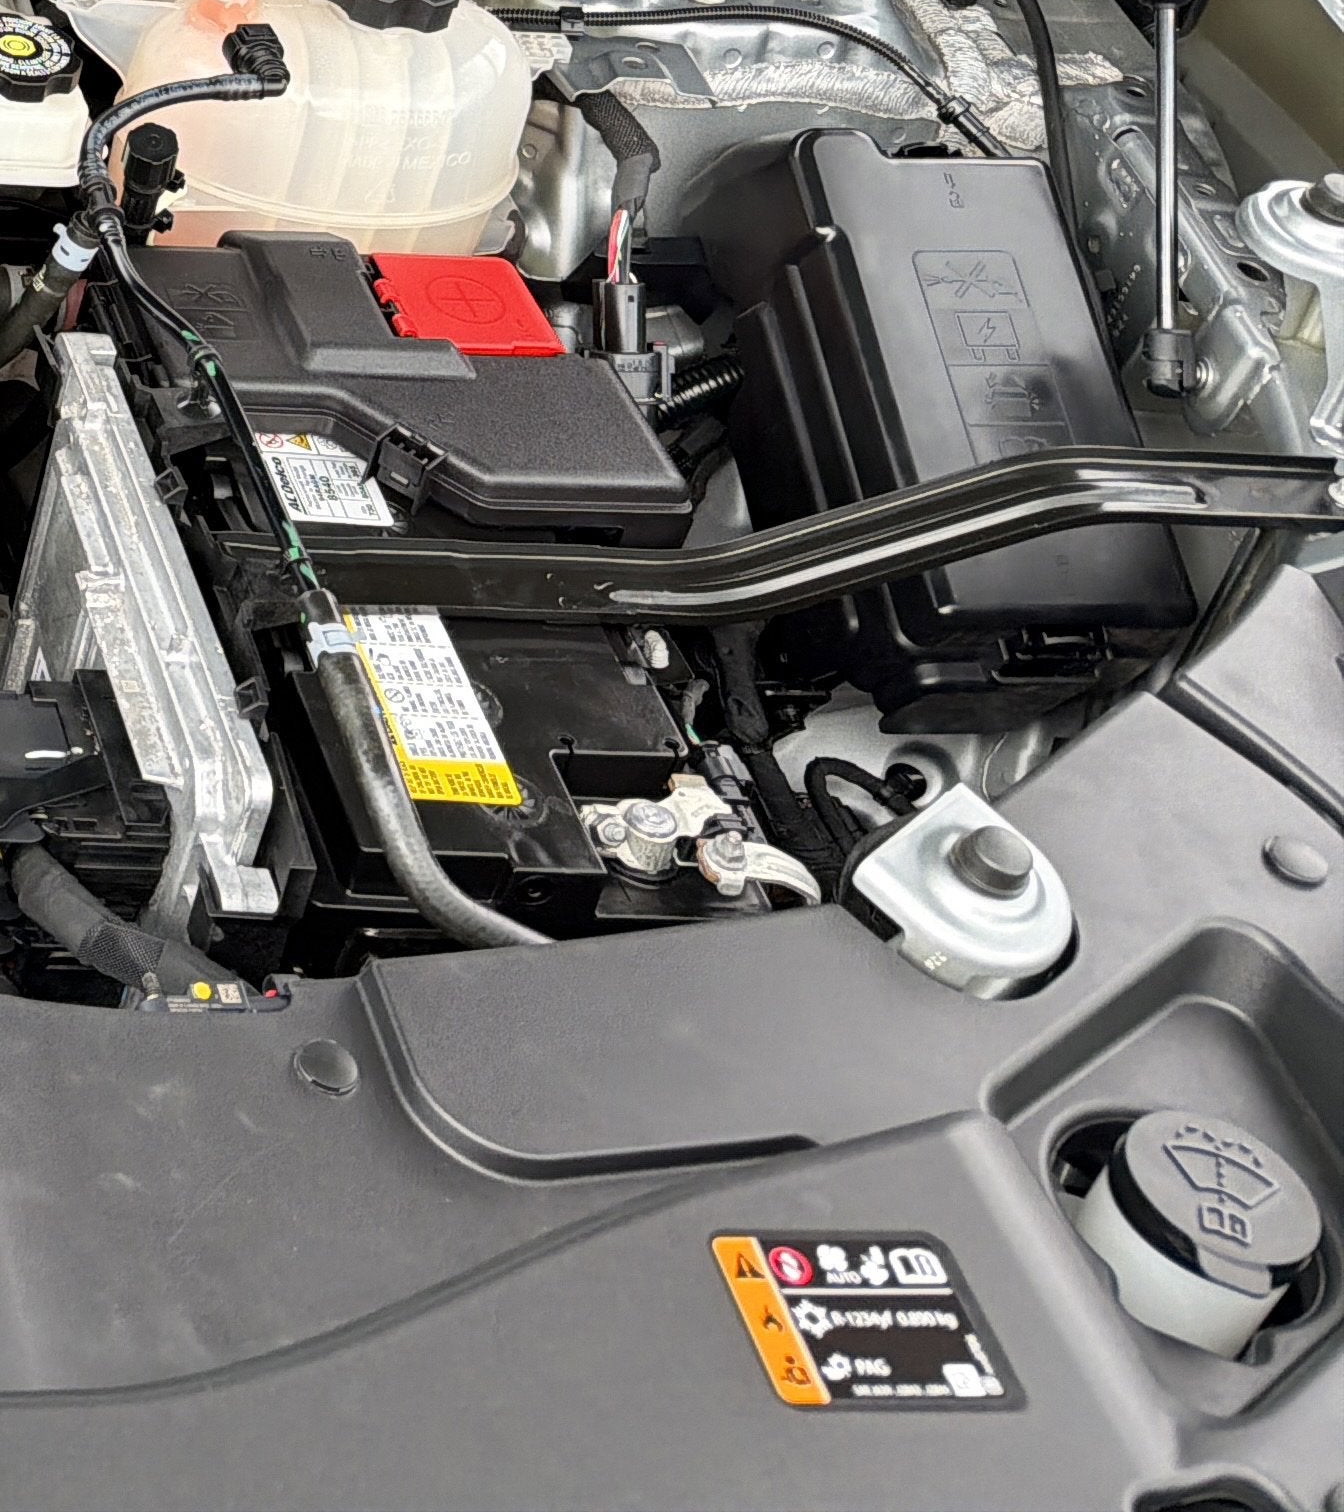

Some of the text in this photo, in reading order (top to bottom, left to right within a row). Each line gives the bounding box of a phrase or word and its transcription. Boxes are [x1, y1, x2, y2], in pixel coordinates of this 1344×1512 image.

[272, 456, 303, 513] ACDelco
[826, 1271, 862, 1284] AUTO
[854, 1358, 892, 1376] PAG
